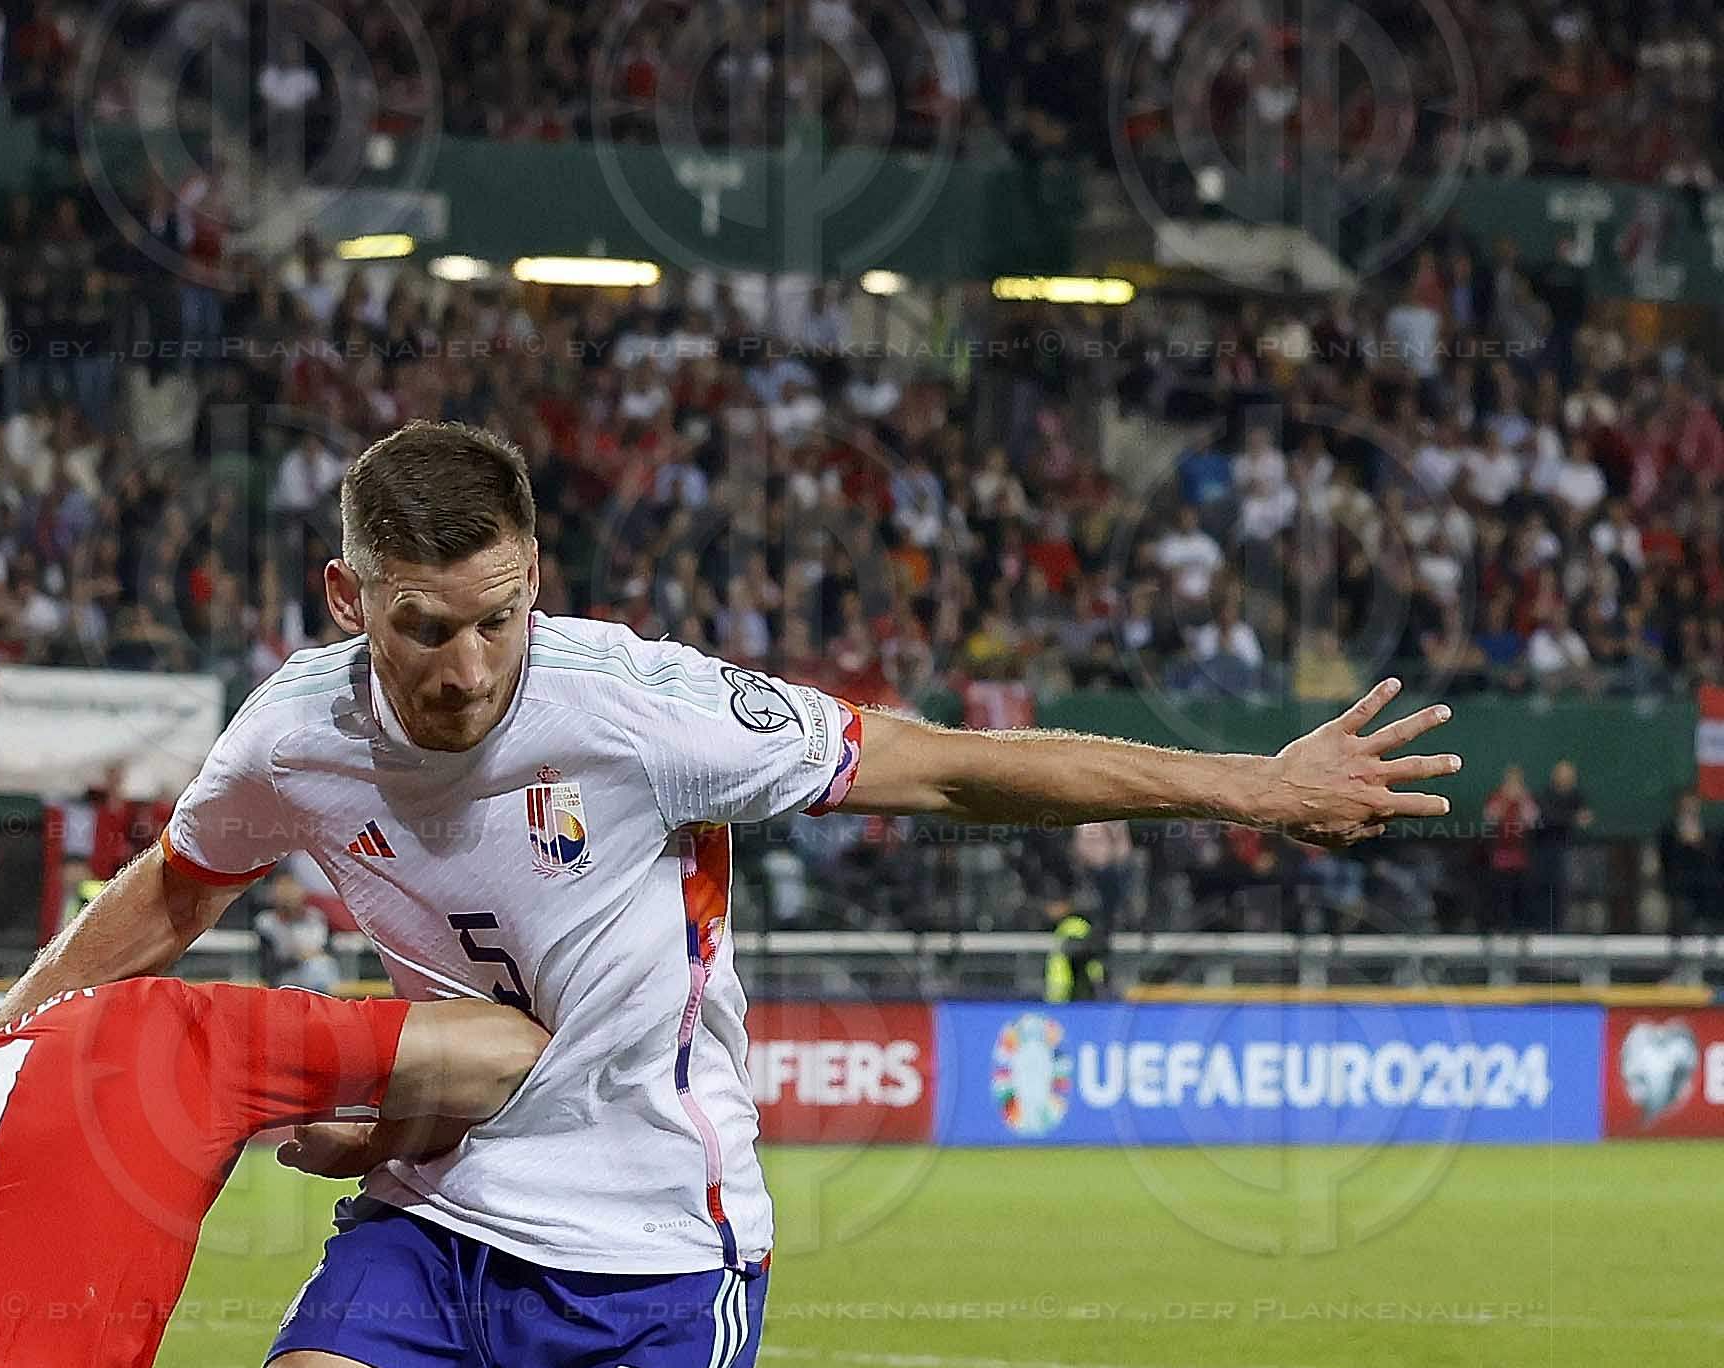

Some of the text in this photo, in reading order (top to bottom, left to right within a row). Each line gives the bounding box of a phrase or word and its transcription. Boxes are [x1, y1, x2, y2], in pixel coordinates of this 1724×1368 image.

[797, 686, 826, 761] FOUNDATIO
[445, 909, 533, 1012] 5
[749, 1040, 924, 1107] IFIERS
